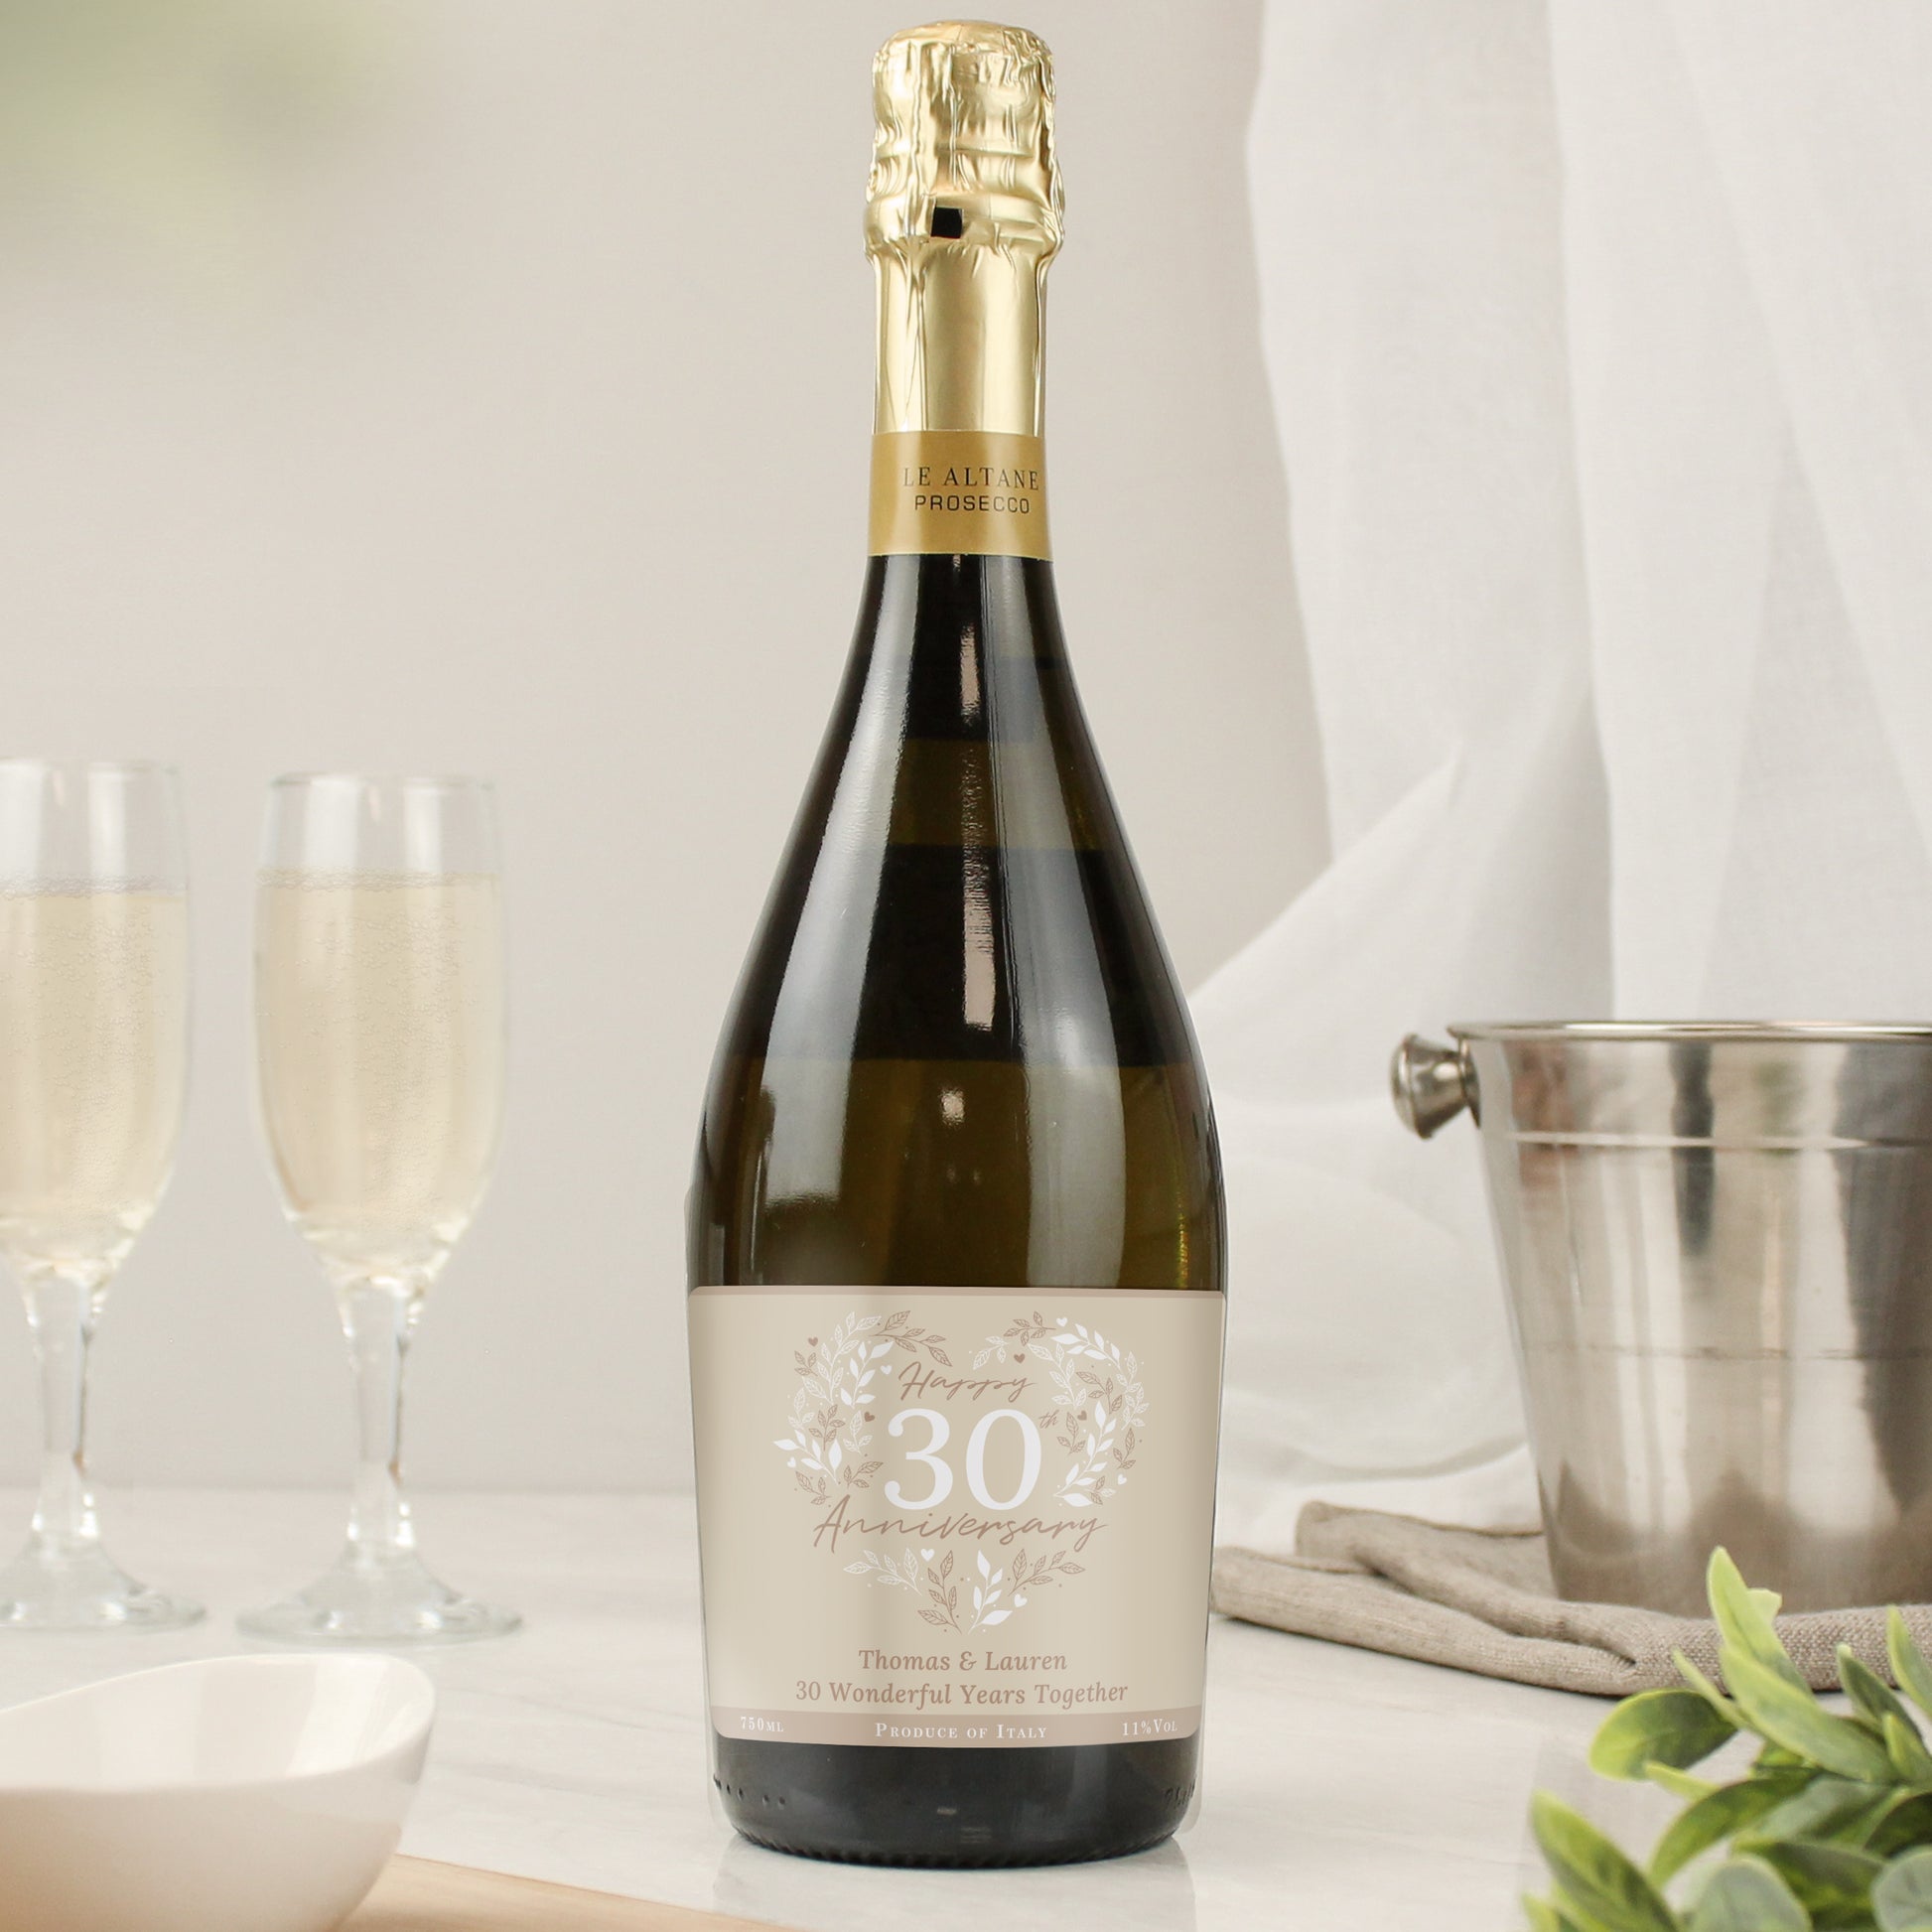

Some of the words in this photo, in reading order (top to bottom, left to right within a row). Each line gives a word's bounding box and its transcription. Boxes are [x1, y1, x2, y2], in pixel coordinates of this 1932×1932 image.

[903, 467, 930, 486] LE
[942, 467, 1039, 490] ALTANE
[914, 495, 1030, 514] PROSECCO
[897, 1361, 1037, 1403] Happy
[813, 1494, 1109, 1553] Anniversary
[858, 1649, 950, 1671] Thomas
[959, 1651, 977, 1671] &
[985, 1650, 1067, 1671] Lauren
[795, 1681, 821, 1701] 30
[829, 1682, 952, 1711] Wonderful
[960, 1684, 1026, 1705] Years
[1035, 1681, 1128, 1710] Together
